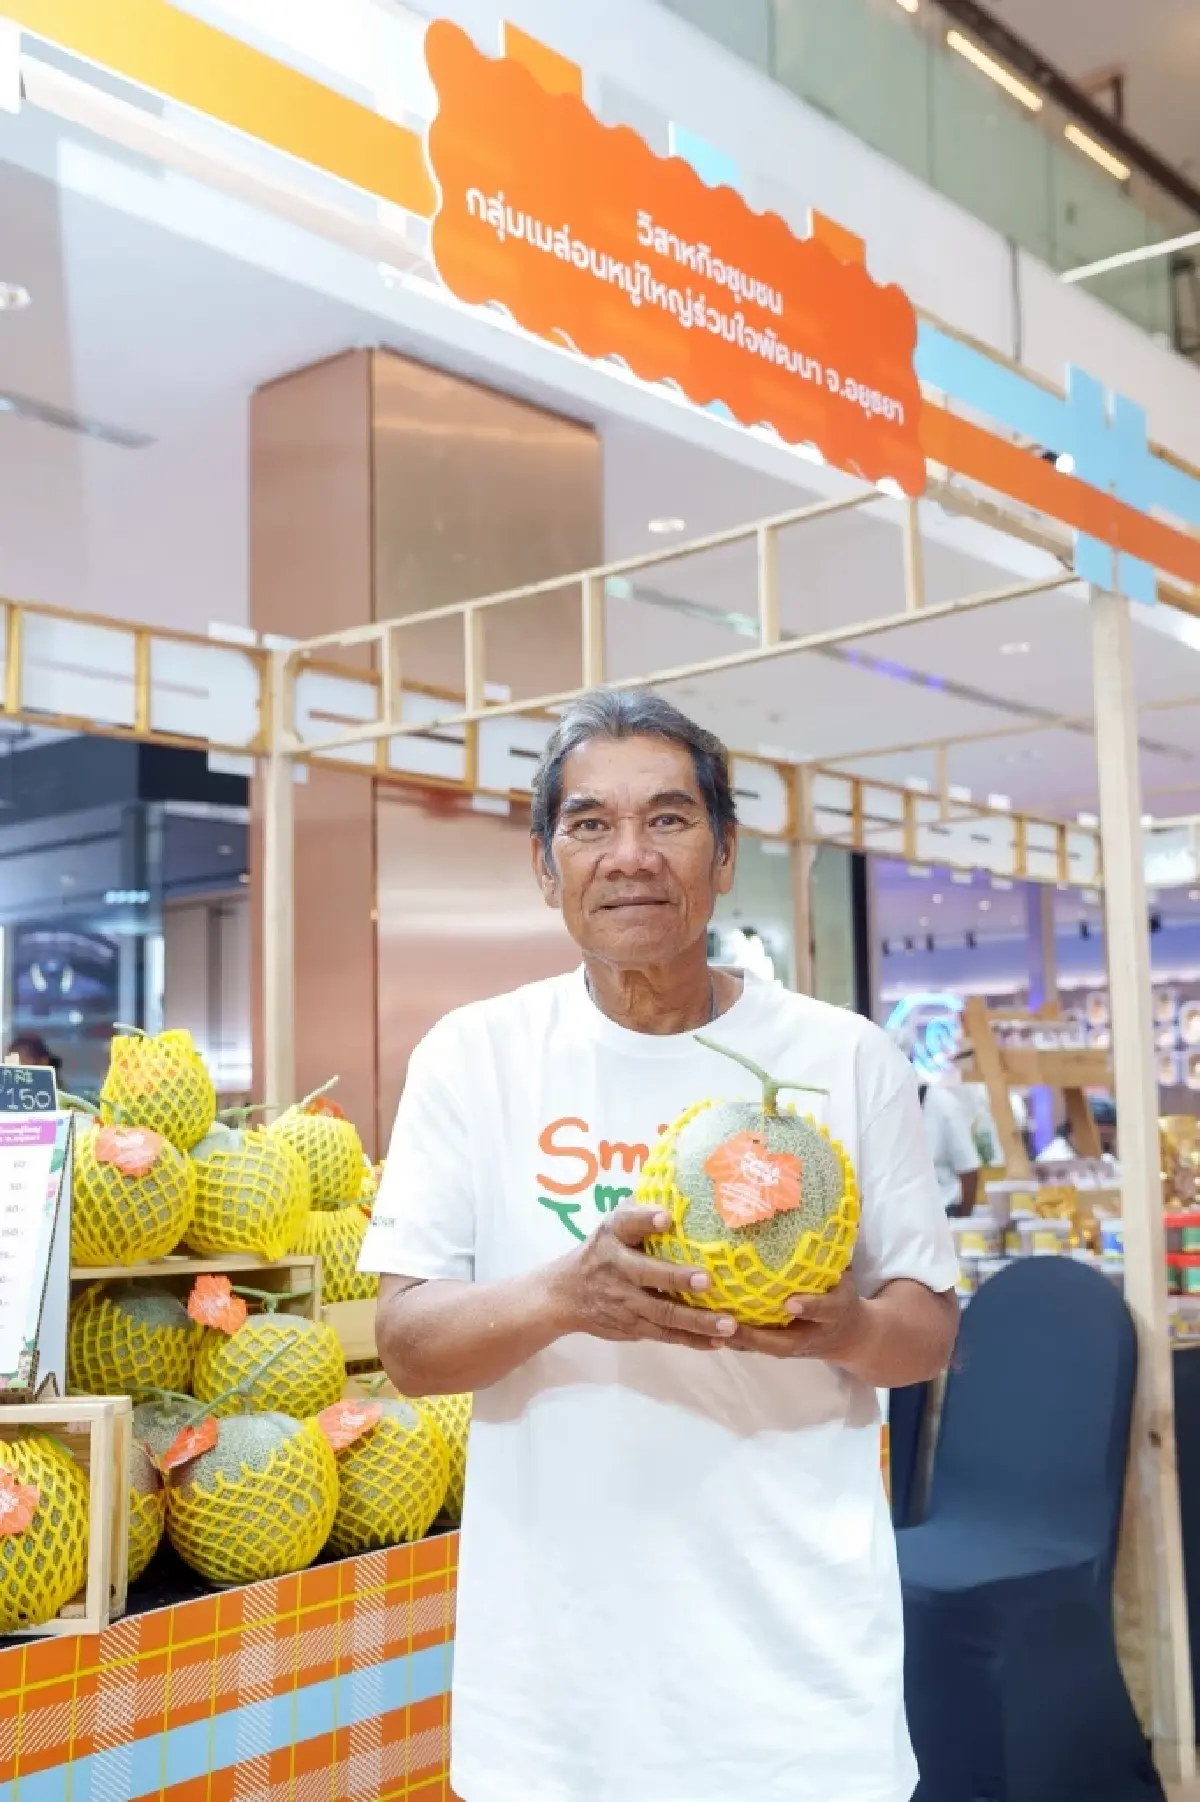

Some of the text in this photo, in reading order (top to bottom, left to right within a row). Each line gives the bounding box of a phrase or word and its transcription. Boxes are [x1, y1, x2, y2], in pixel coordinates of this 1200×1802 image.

[636, 208, 783, 316] วิสาหกิจชุมชน
[825, 368, 905, 425] จ.อยุธยา
[536, 1116, 669, 1196] Sm
